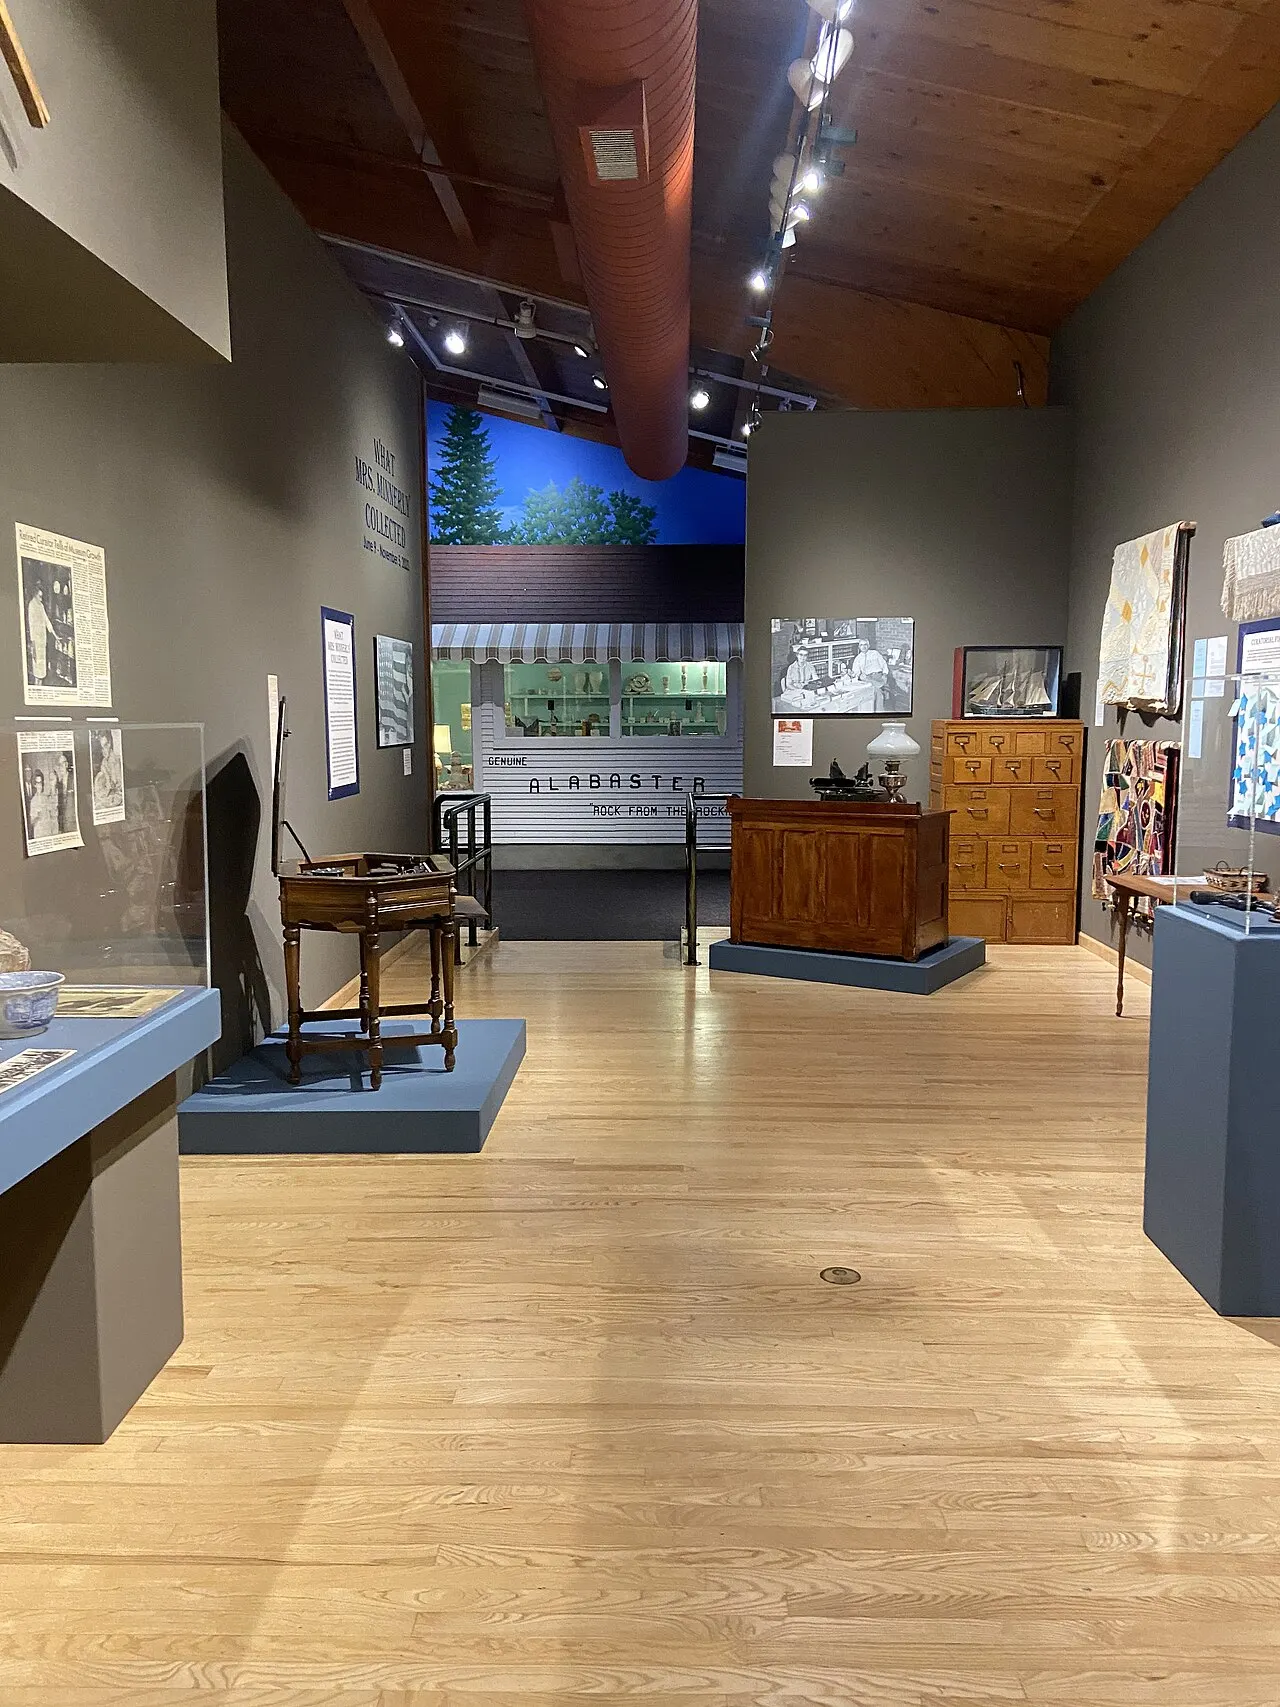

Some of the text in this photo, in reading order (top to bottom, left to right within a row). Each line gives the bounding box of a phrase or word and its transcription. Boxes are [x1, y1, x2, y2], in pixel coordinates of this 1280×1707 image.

[373, 438, 395, 477] WHAT
[355, 455, 375, 493] MRS.
[365, 502, 406, 549] COLLECTED
[69, 544, 87, 558] Museum
[363, 535, 373, 552] June
[379, 543, 398, 565] November
[488, 755, 528, 766] GENUINE
[529, 773, 705, 793] ALABASTER
[628, 806, 658, 816] FROM
[666, 806, 687, 816] THE
